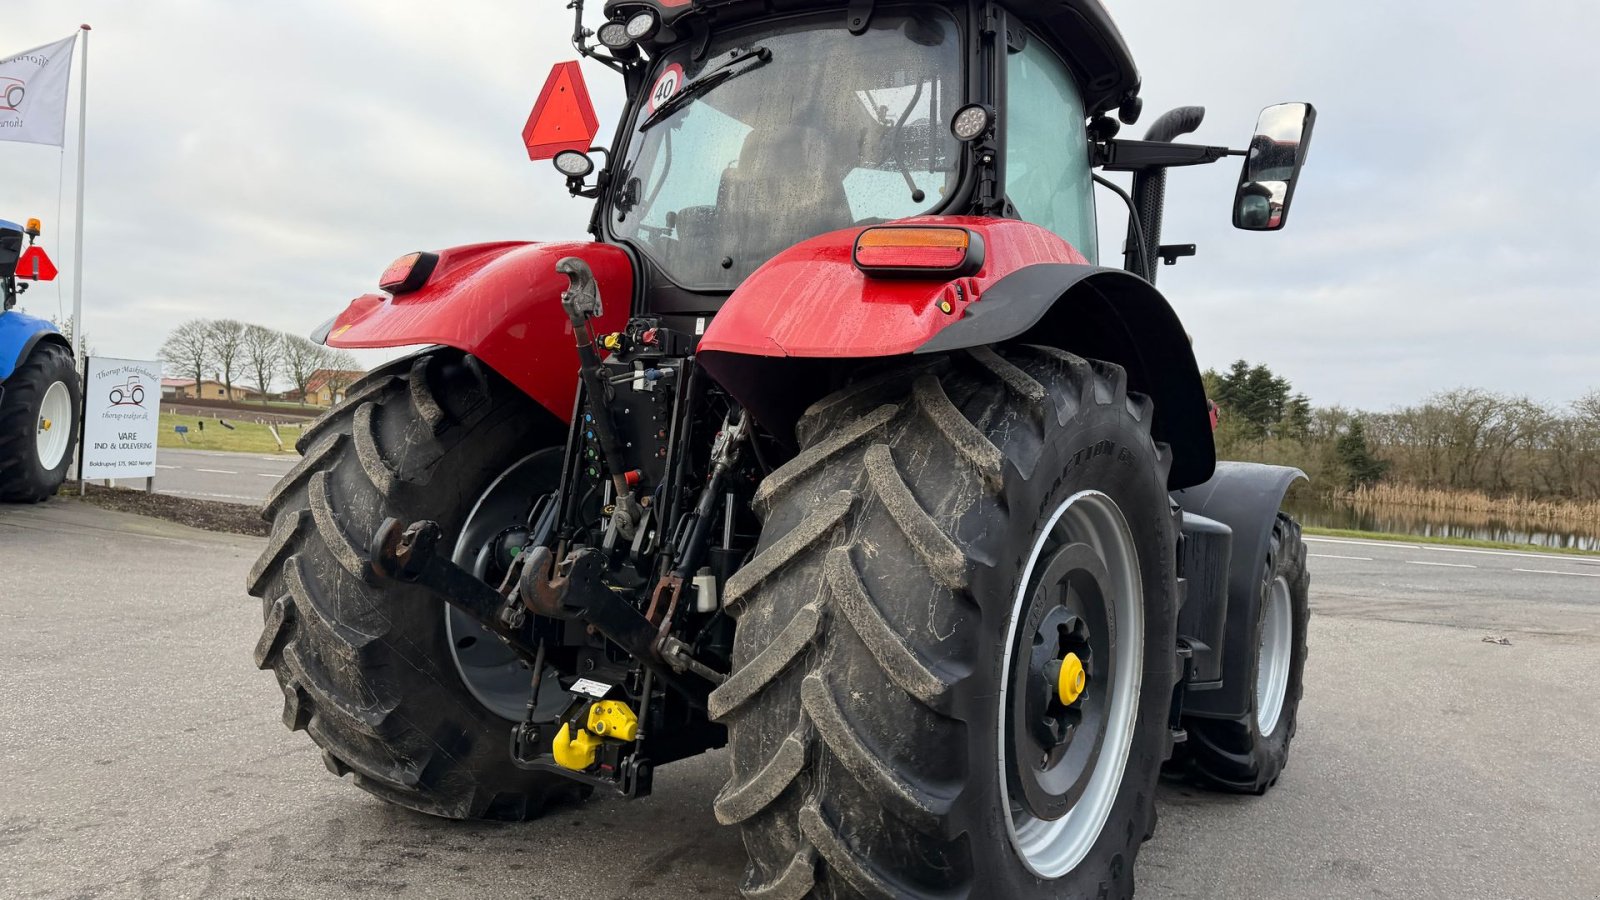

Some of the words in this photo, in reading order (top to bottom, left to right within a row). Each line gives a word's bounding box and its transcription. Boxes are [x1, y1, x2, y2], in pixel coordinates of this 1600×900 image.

[654, 78, 673, 101] 40
[95, 367, 120, 380] Thorup
[118, 432, 137, 440] VARE
